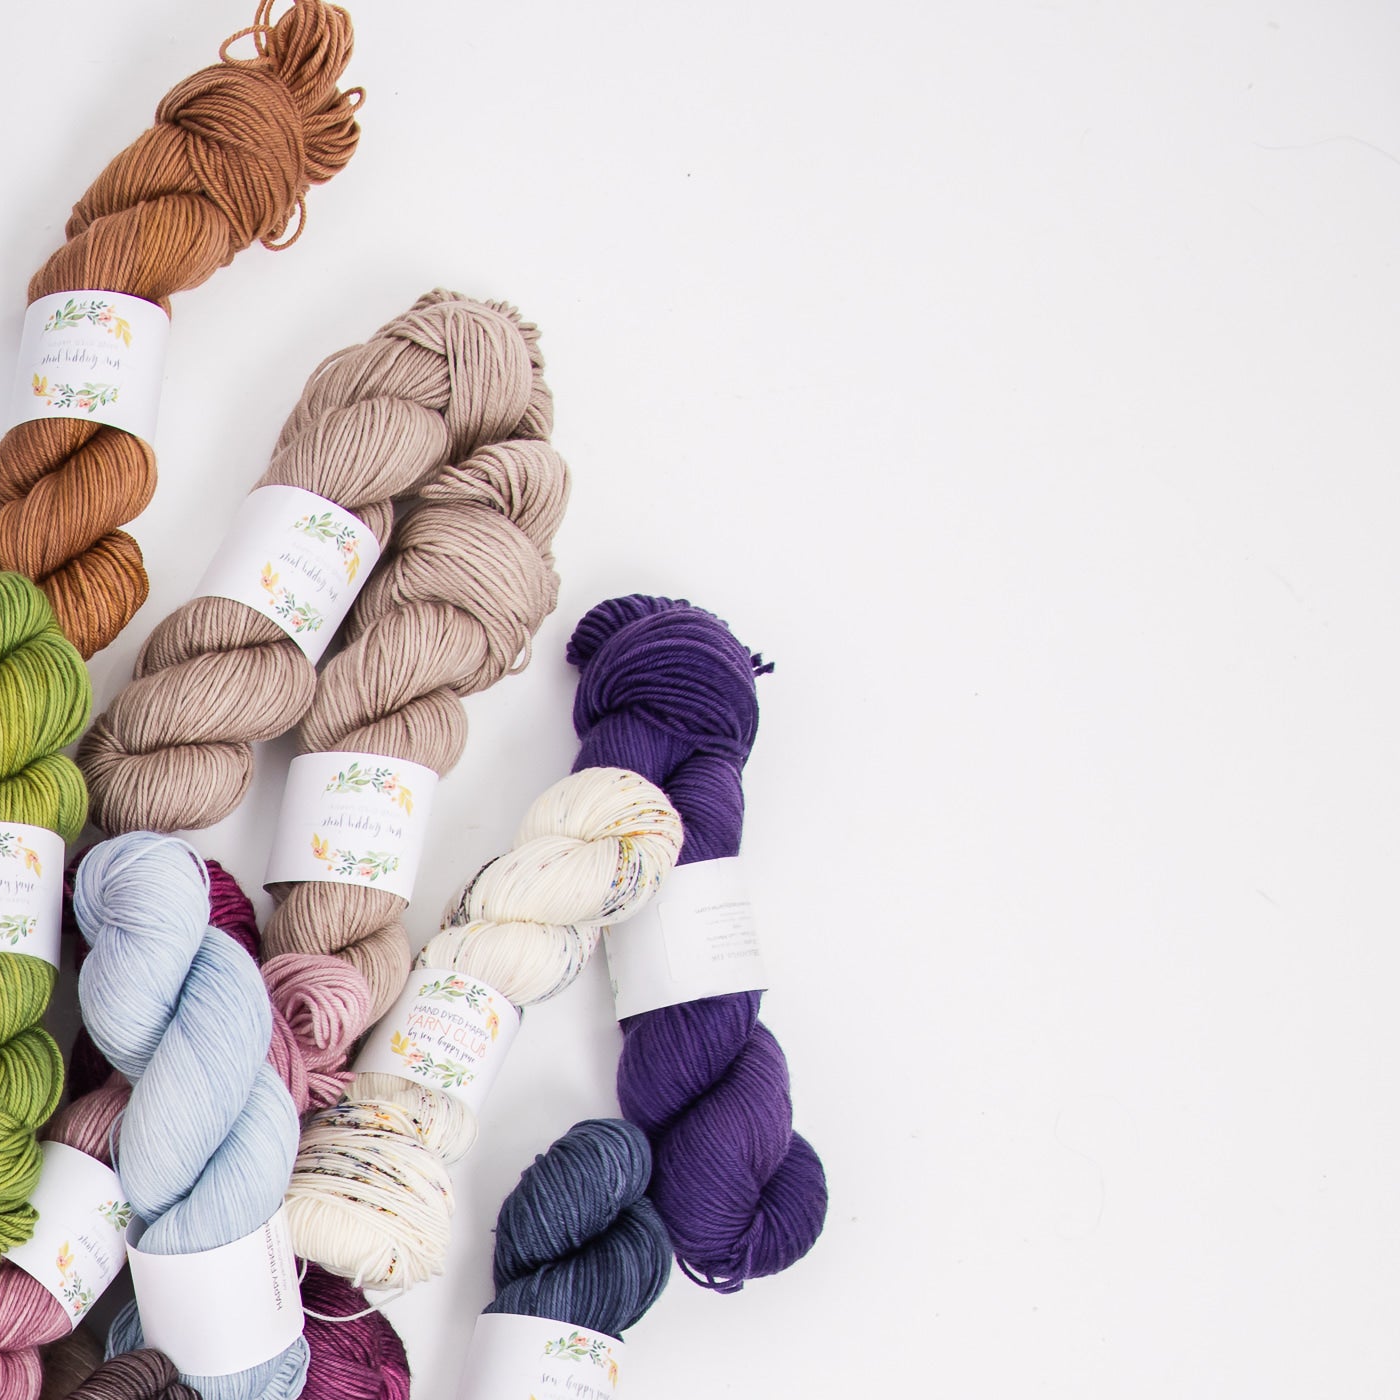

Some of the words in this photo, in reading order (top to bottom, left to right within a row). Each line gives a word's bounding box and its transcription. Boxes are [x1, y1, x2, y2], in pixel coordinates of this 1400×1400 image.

[41, 350, 61, 365] jane
[65, 348, 98, 370] happy
[106, 357, 120, 369] sew
[15, 874, 35, 894] jane
[413, 1004, 440, 1021] HAND
[440, 1010, 464, 1026] DYED
[461, 1021, 490, 1041] HAPPY
[406, 1012, 452, 1036] YARN
[453, 1027, 487, 1059] CLUB
[437, 1035, 460, 1058] happy
[271, 1276, 283, 1311] HAPPY
[565, 1374, 594, 1400] happy
